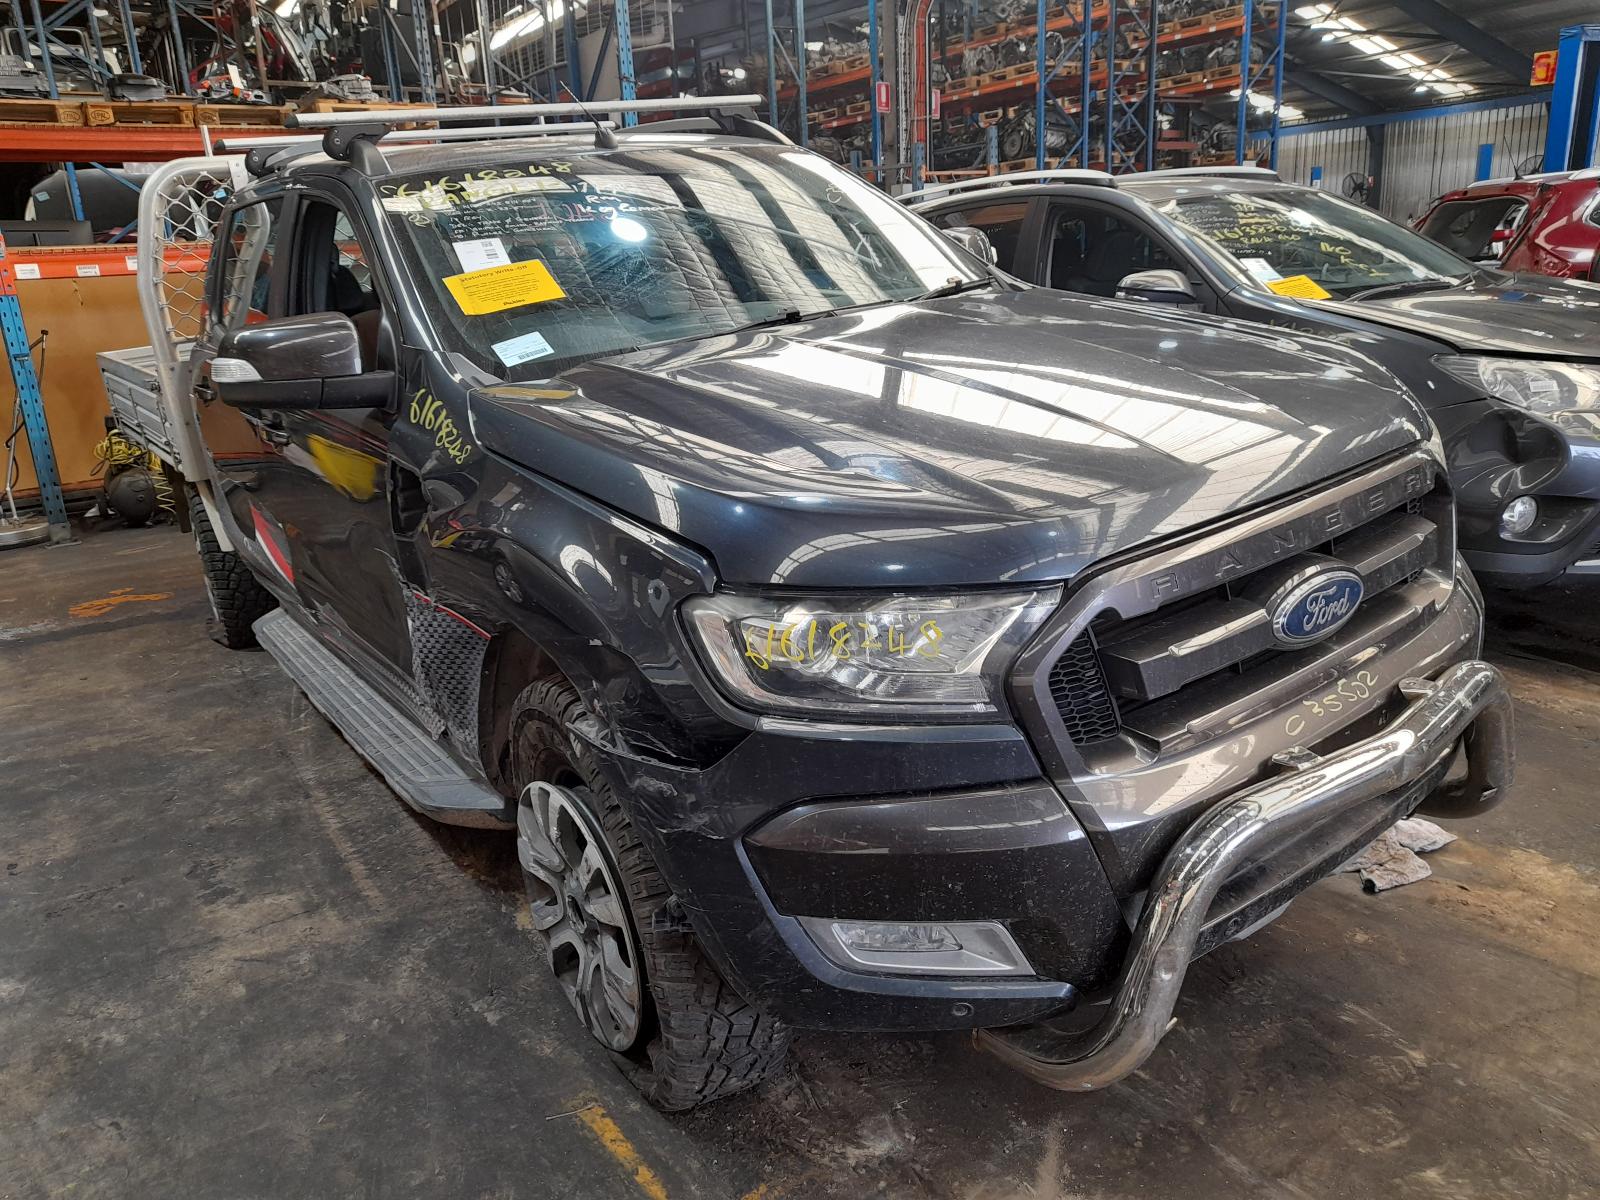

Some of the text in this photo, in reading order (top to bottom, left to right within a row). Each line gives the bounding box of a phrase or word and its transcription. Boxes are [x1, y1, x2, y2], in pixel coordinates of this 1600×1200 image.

[396, 161, 573, 198] 61618248
[409, 388, 472, 464] 61618248
[1150, 463, 1424, 599] RANGER
[1303, 584, 1351, 632] Ford
[745, 618, 944, 670] 61618248
